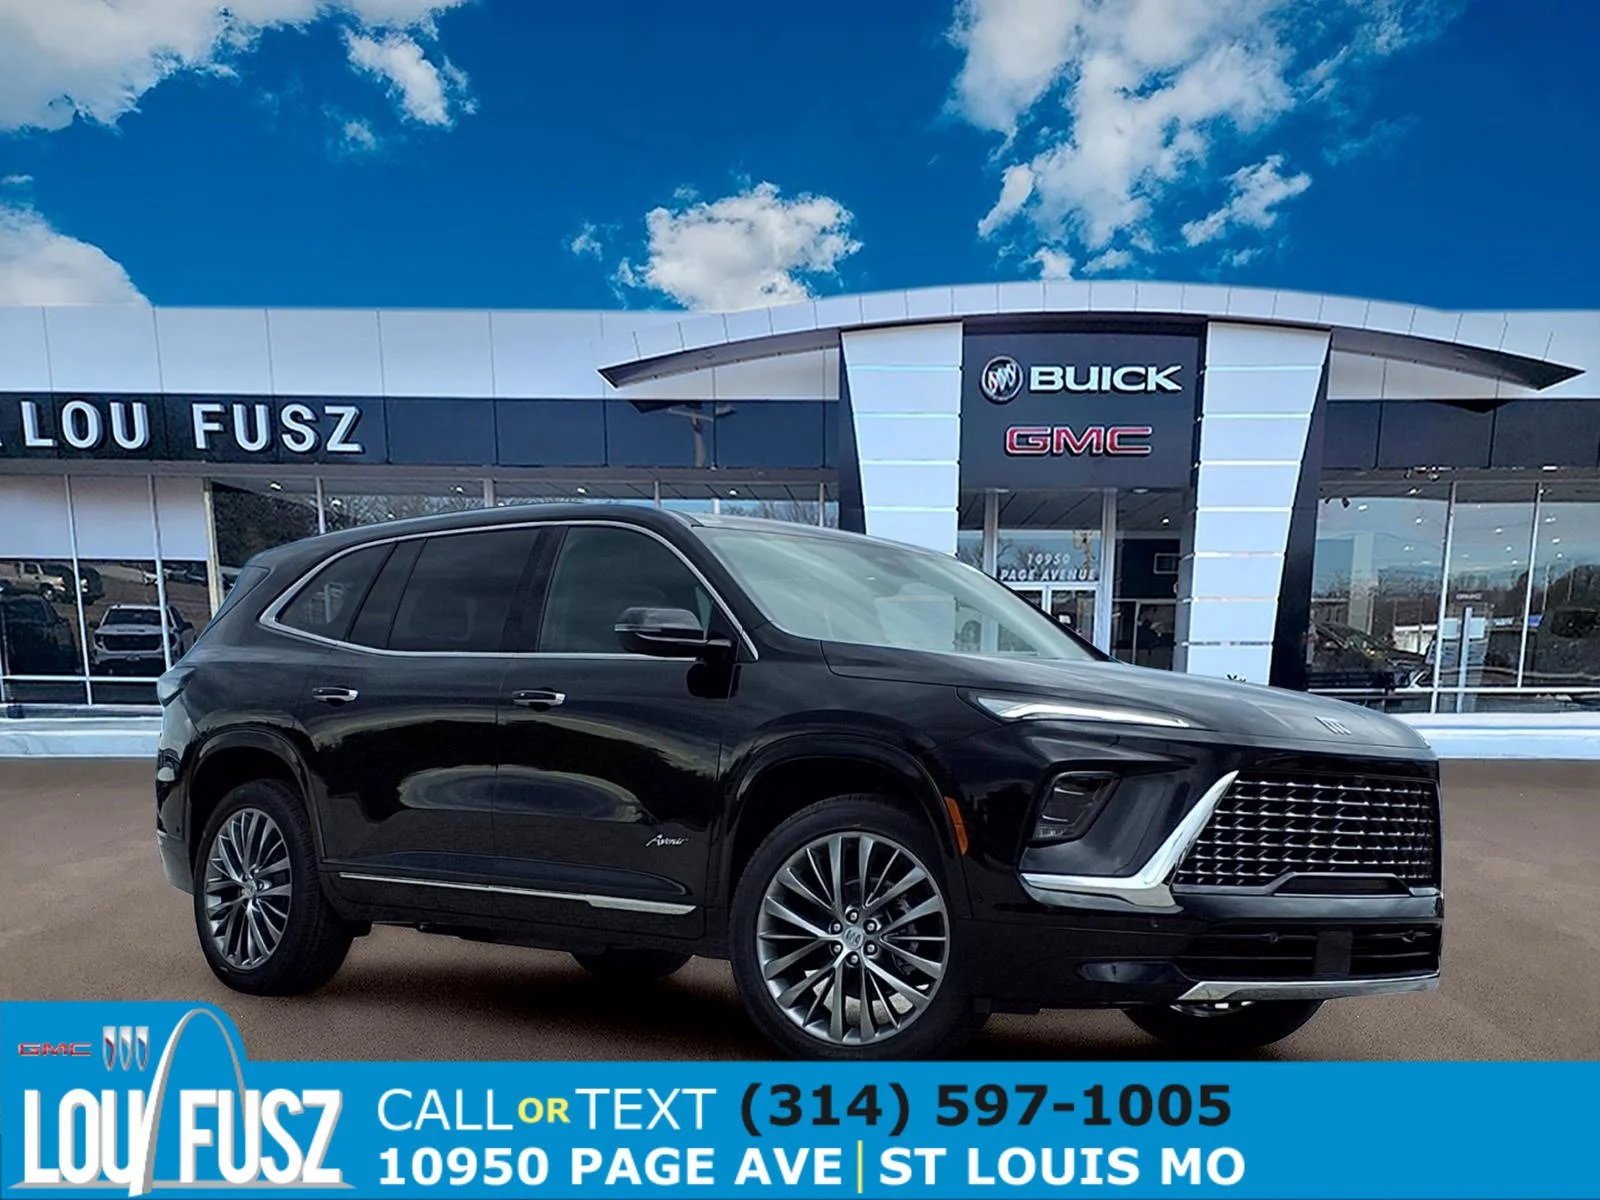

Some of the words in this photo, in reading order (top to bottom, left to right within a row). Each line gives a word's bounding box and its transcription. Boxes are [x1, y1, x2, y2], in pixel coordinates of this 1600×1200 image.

[1029, 364, 1183, 392] BUICK
[20, 399, 149, 449] LOU
[191, 402, 364, 453] FUSZ
[1006, 426, 1153, 455] GMC
[1027, 553, 1071, 565] 10950
[1000, 569, 1036, 581] PAGE
[1040, 569, 1095, 581] AVENUE
